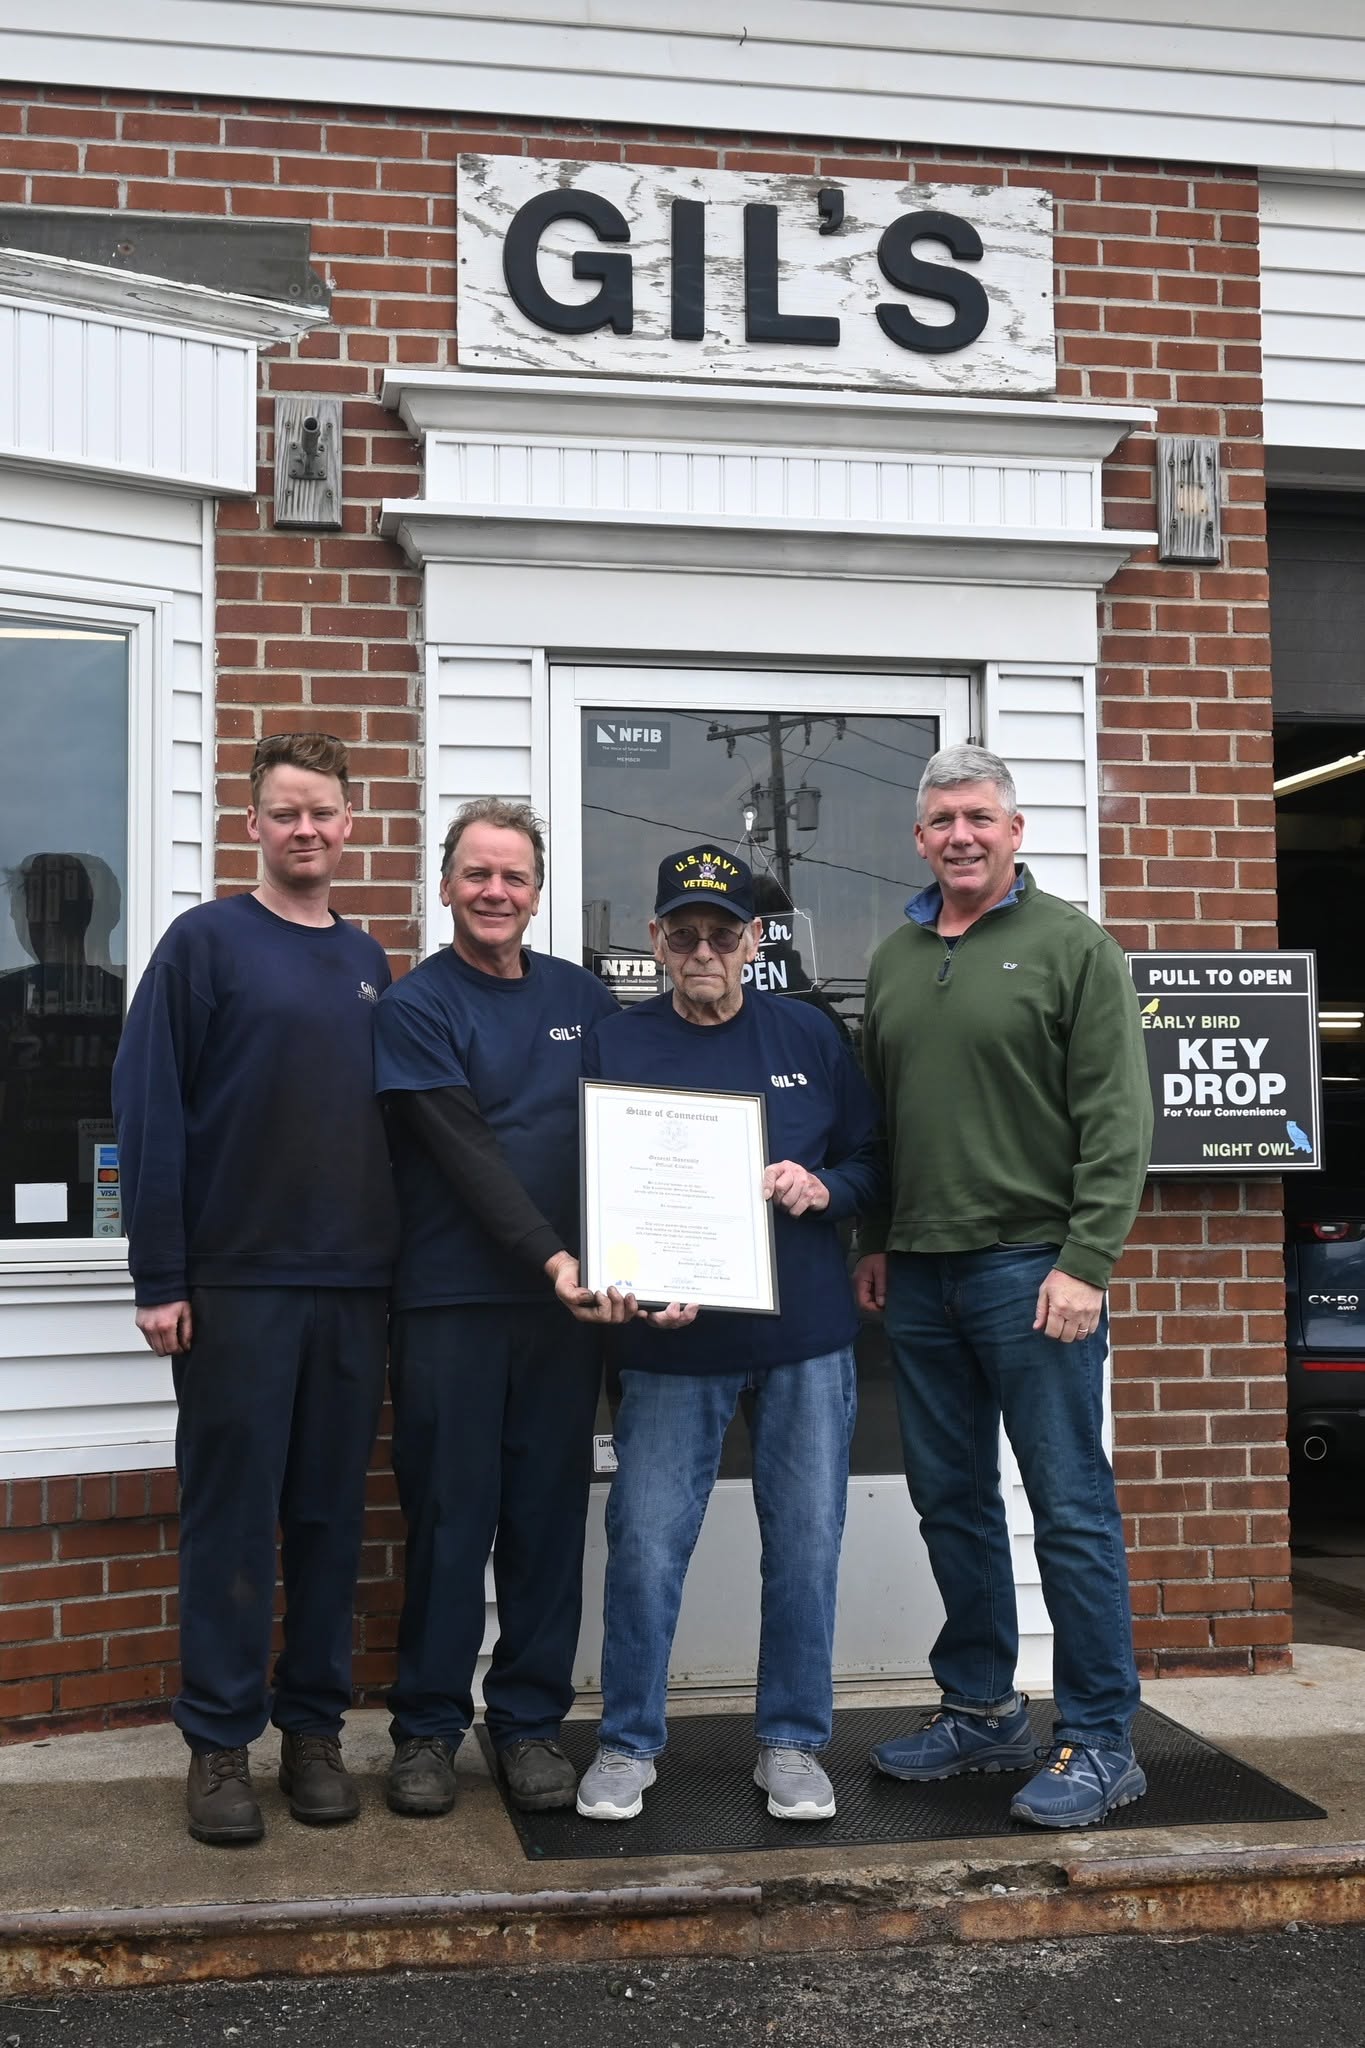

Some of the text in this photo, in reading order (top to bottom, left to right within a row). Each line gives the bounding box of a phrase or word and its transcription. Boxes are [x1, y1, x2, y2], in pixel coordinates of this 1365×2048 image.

[503, 188, 990, 354] GIL'S
[619, 727, 662, 743] NFIB
[675, 853, 739, 876] U.S. NAVY
[683, 880, 727, 892] VETERAN
[768, 920, 792, 941] in
[600, 959, 657, 977] NFIB
[740, 960, 788, 991] PEN
[1149, 969, 1292, 985] PULL TO OPEN
[1141, 1015, 1241, 1029] EARLY BIRD
[1178, 1038, 1270, 1070] KEY
[770, 1073, 808, 1088] GIL'S
[1163, 1072, 1287, 1105] DROP
[626, 1106, 719, 1122] State of Connecticut
[1163, 1107, 1287, 1117] For Your Convenience
[1203, 1142, 1295, 1157] NIGHT OWL
[1308, 1294, 1359, 1305] CX-50
